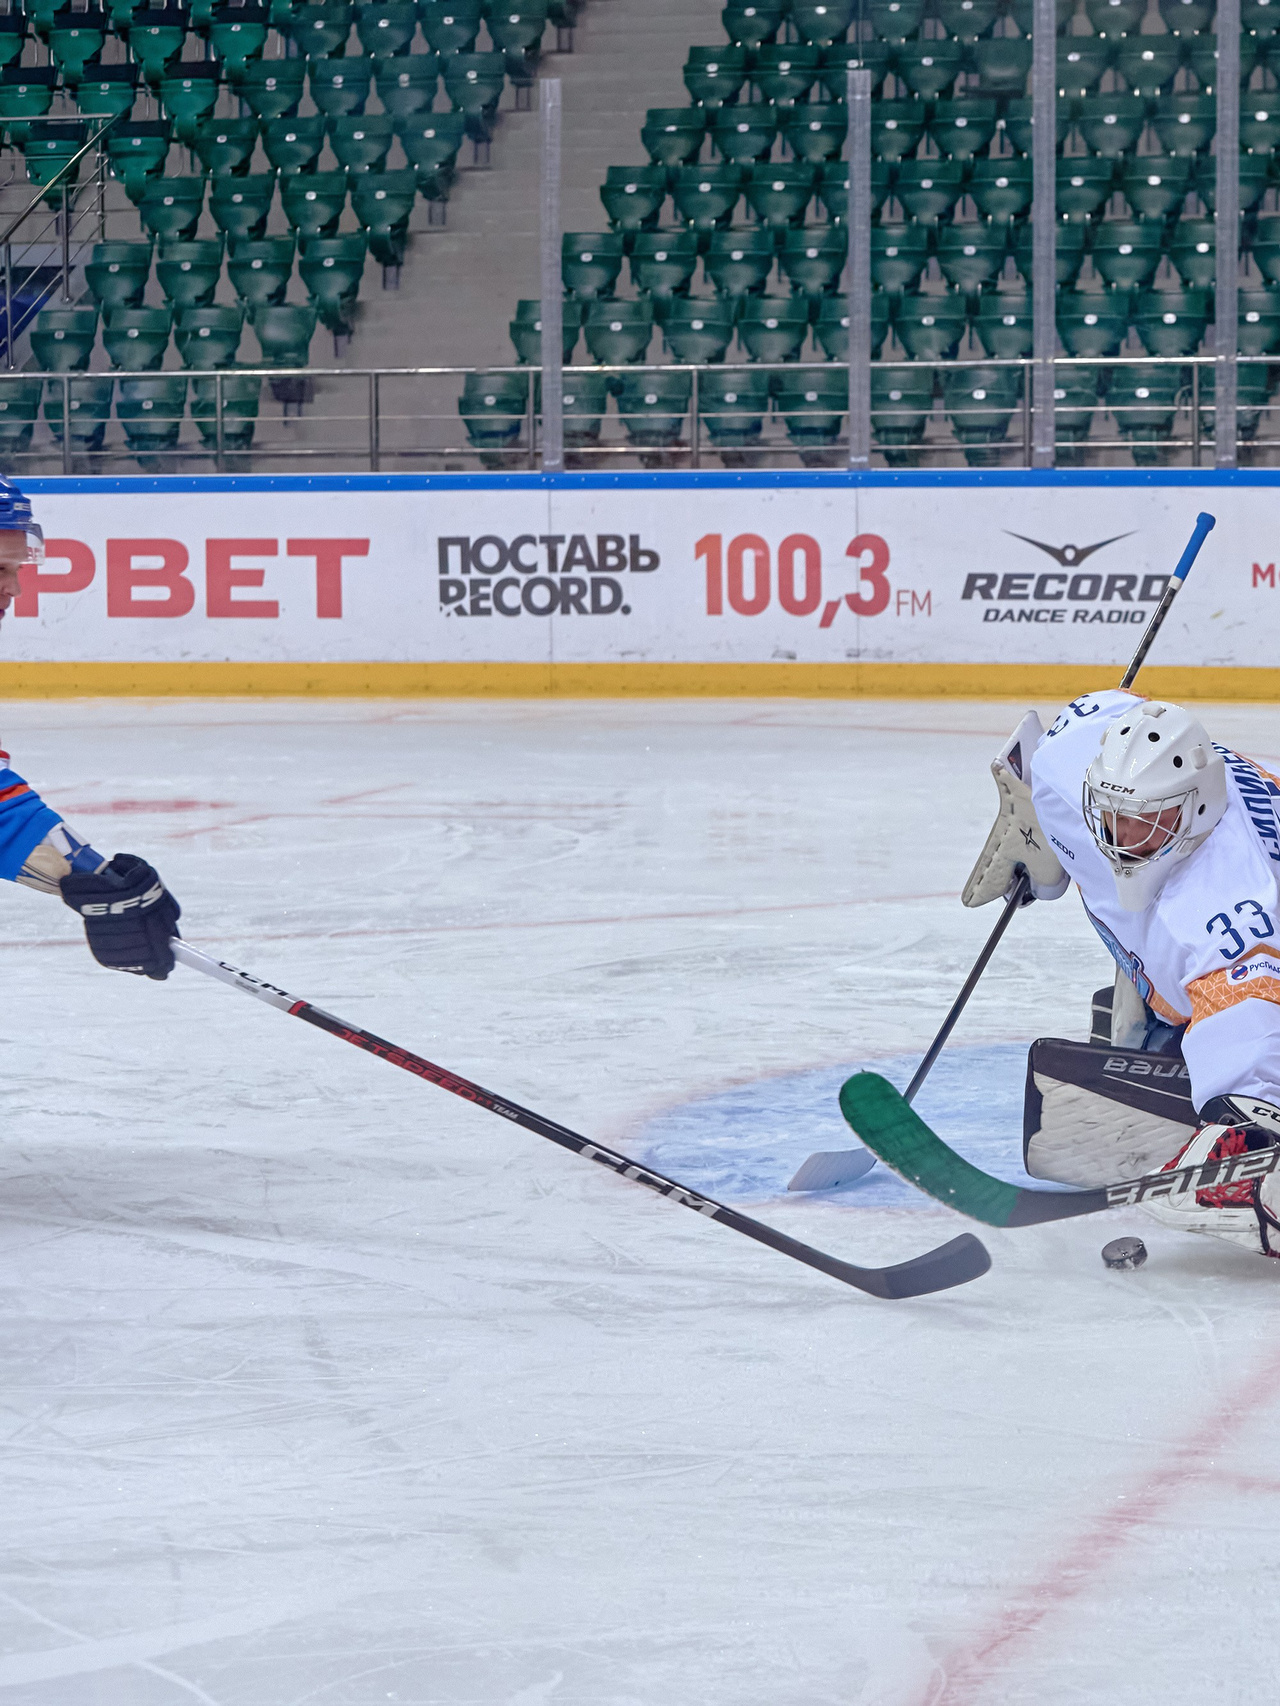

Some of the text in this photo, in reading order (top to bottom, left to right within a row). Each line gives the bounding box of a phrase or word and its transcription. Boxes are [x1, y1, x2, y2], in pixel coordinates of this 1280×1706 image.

[438, 534, 660, 575] ПОСТАВЬ
[439, 577, 632, 617] RECORD.
[694, 533, 932, 628] 100,3 FM
[961, 573, 1172, 602] RECORD
[983, 609, 1147, 624] DANCE RADIO
[1100, 781, 1136, 795] CCM
[81, 880, 166, 917] EFS
[1205, 899, 1275, 960] 33
[219, 962, 290, 997] CCM
[1102, 1056, 1190, 1079] BAU
[492, 1103, 519, 1120] TEAM
[579, 1144, 721, 1218] CCM
